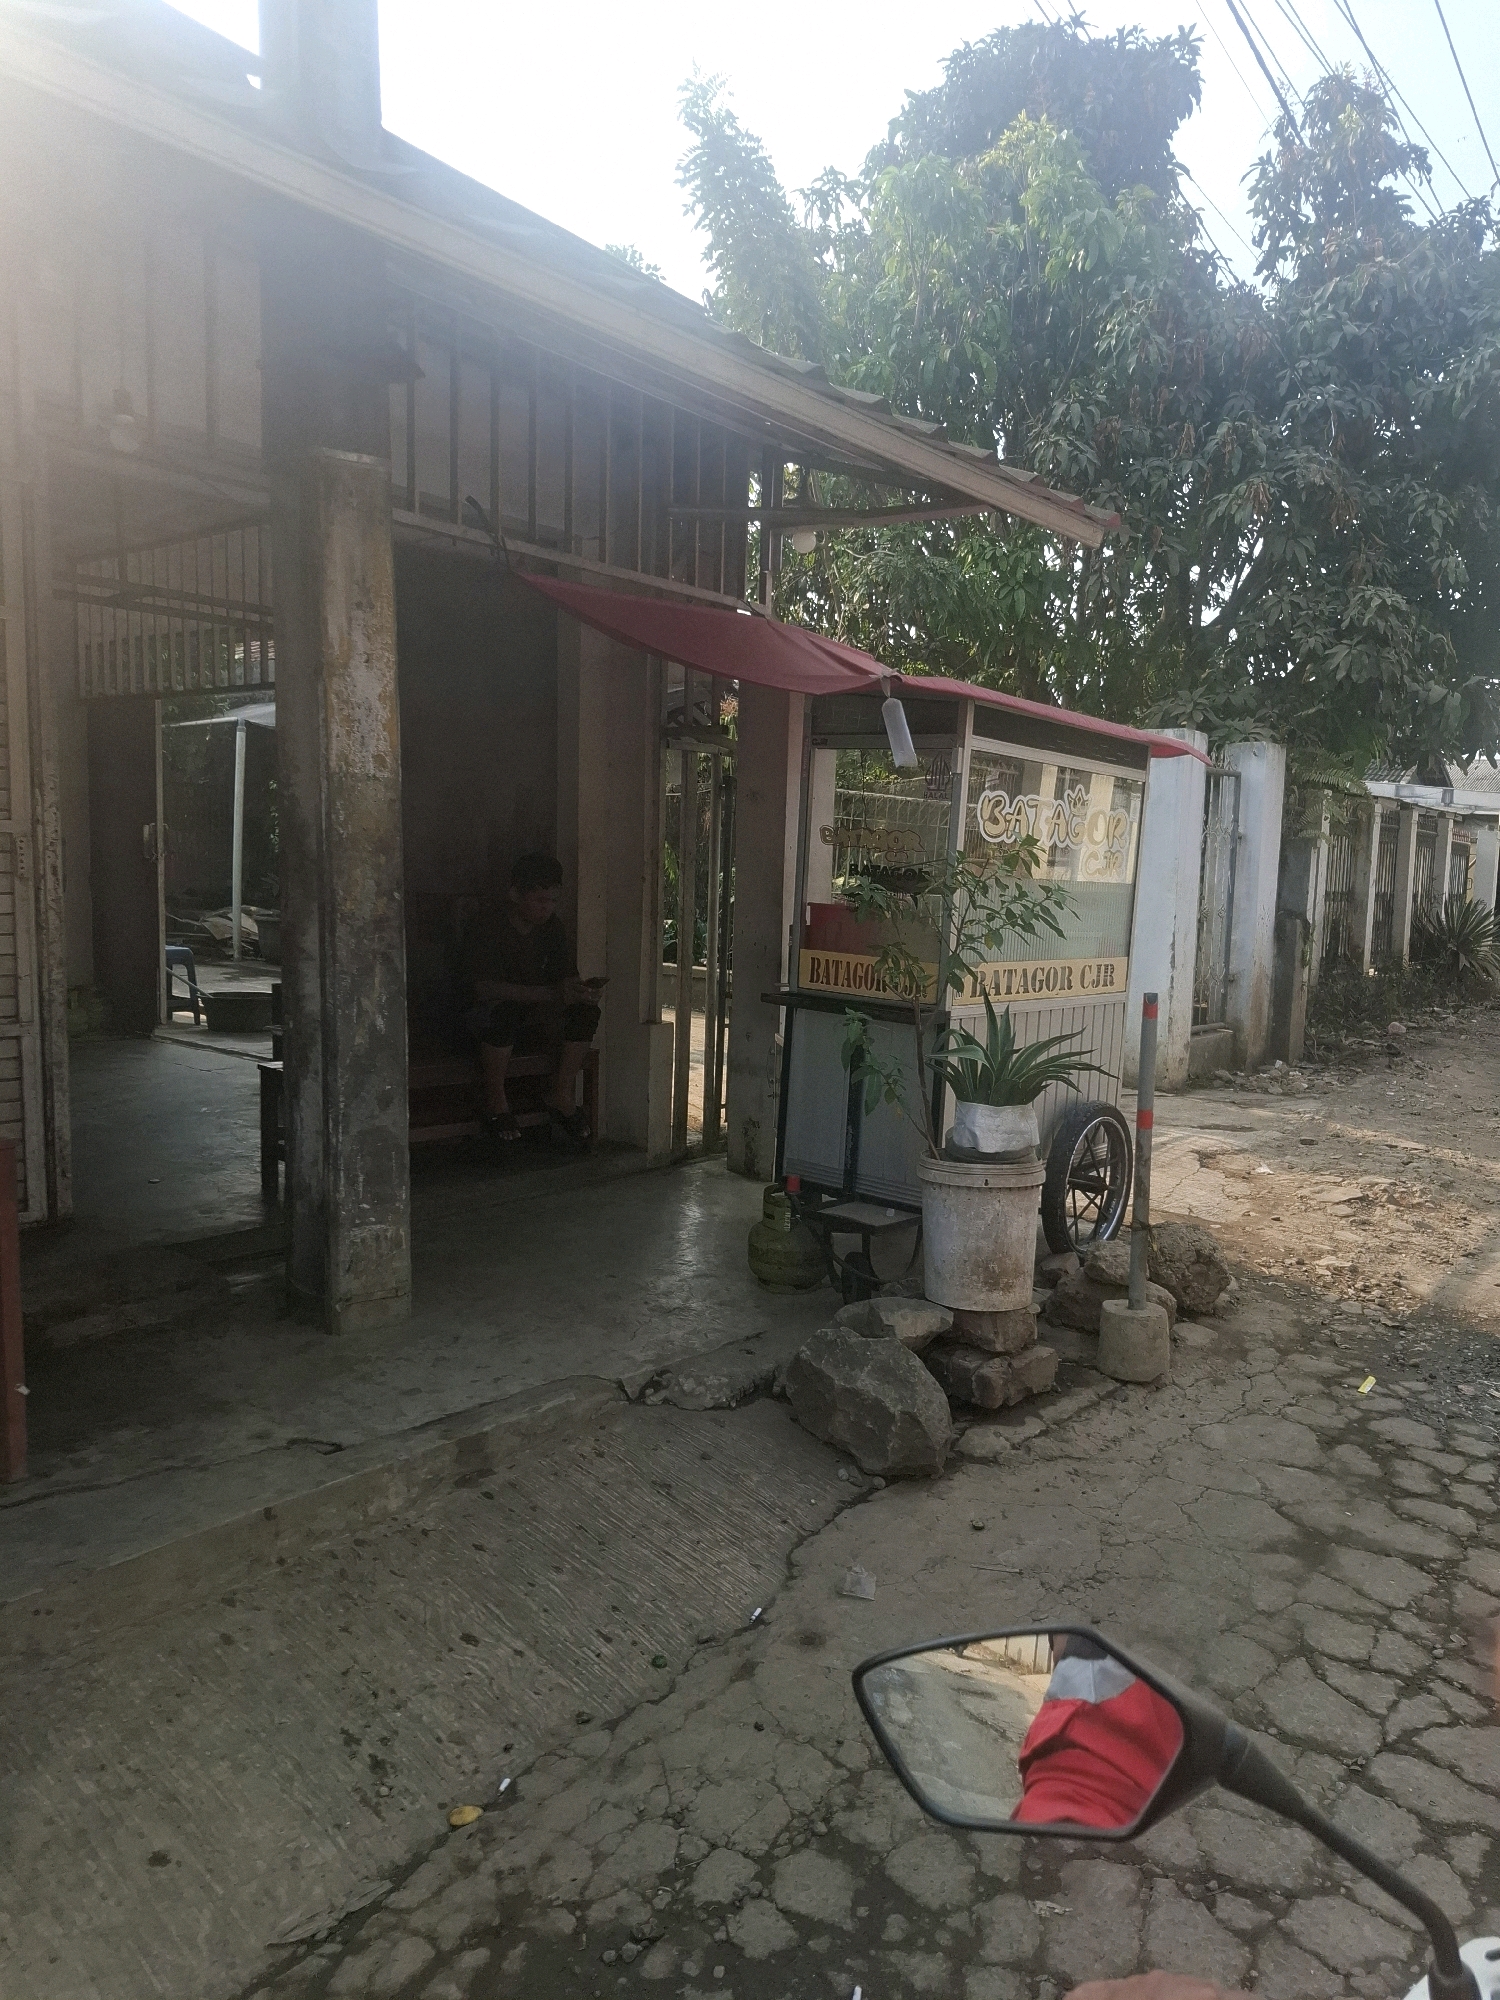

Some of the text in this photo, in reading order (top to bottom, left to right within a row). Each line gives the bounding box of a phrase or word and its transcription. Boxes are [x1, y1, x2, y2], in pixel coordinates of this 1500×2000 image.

[923, 791, 949, 799] HALAL
[978, 790, 1131, 850] BATAGOR
[1082, 850, 1125, 879] CJR
[969, 963, 1115, 998] BATAGOR CJR
